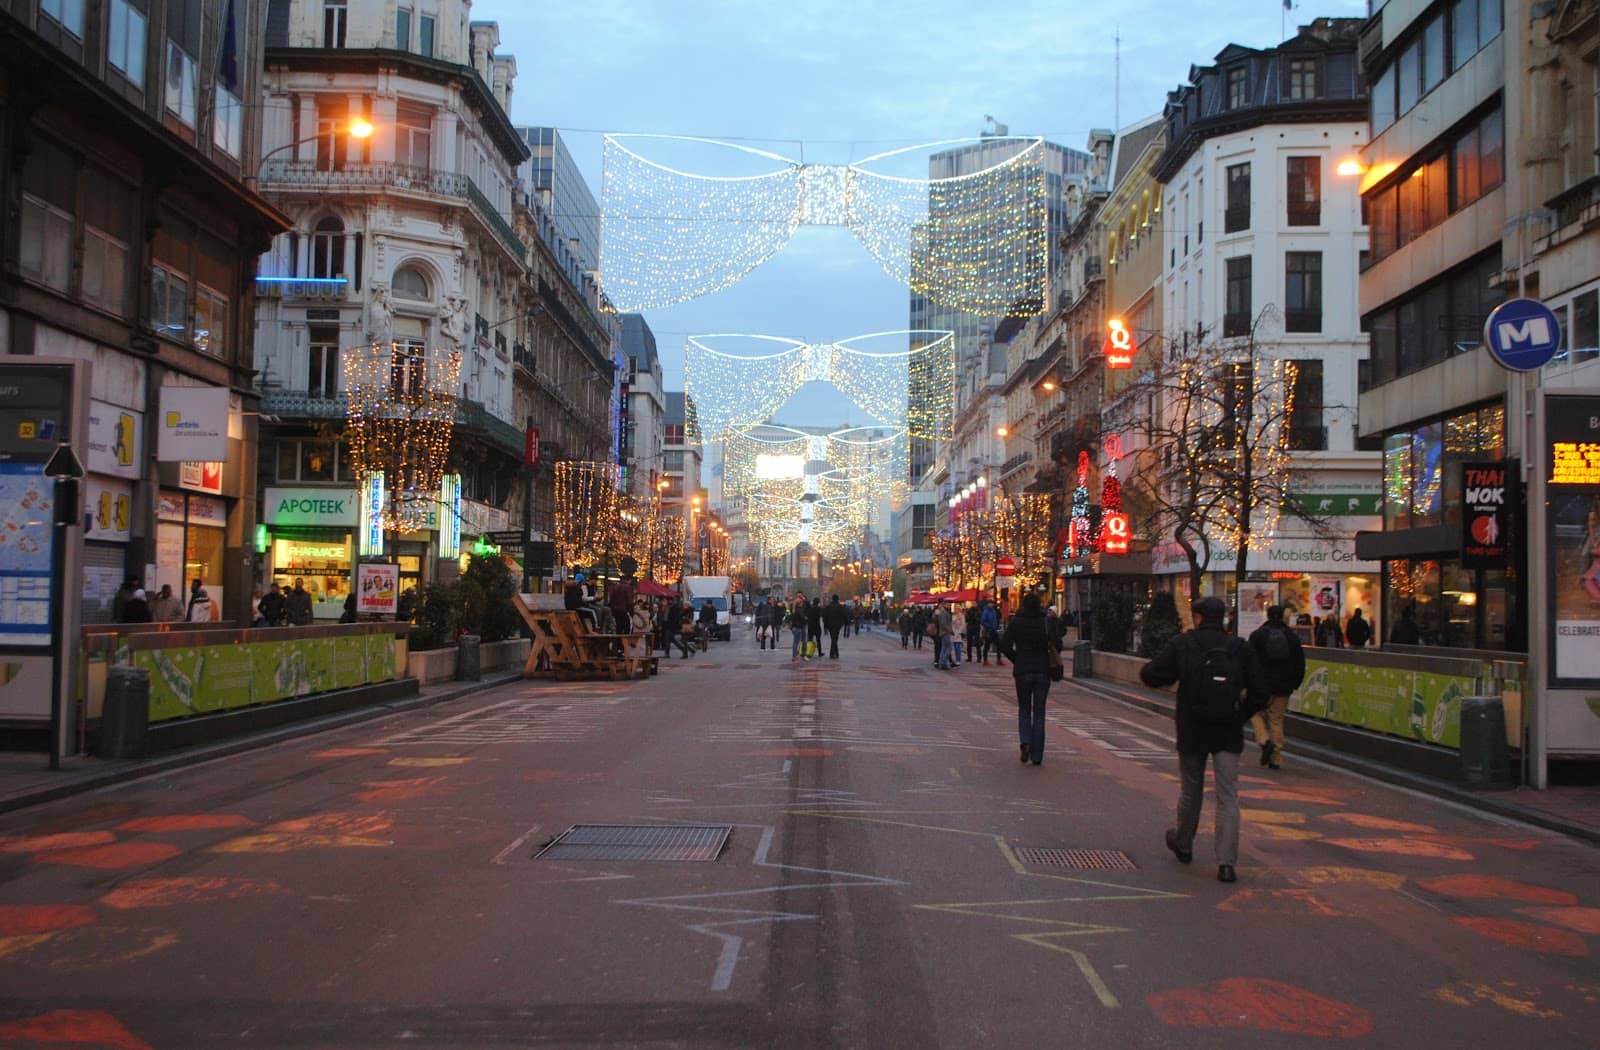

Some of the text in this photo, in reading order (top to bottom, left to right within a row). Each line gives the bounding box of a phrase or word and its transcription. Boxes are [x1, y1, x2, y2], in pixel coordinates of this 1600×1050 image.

[1498, 317, 1550, 350] M
[1465, 470, 1505, 487] THAI
[1465, 487, 1505, 504] WOK
[278, 499, 344, 514] APOTEEK
[1109, 517, 1127, 537] Q
[1269, 549, 1328, 562] Mobistar
